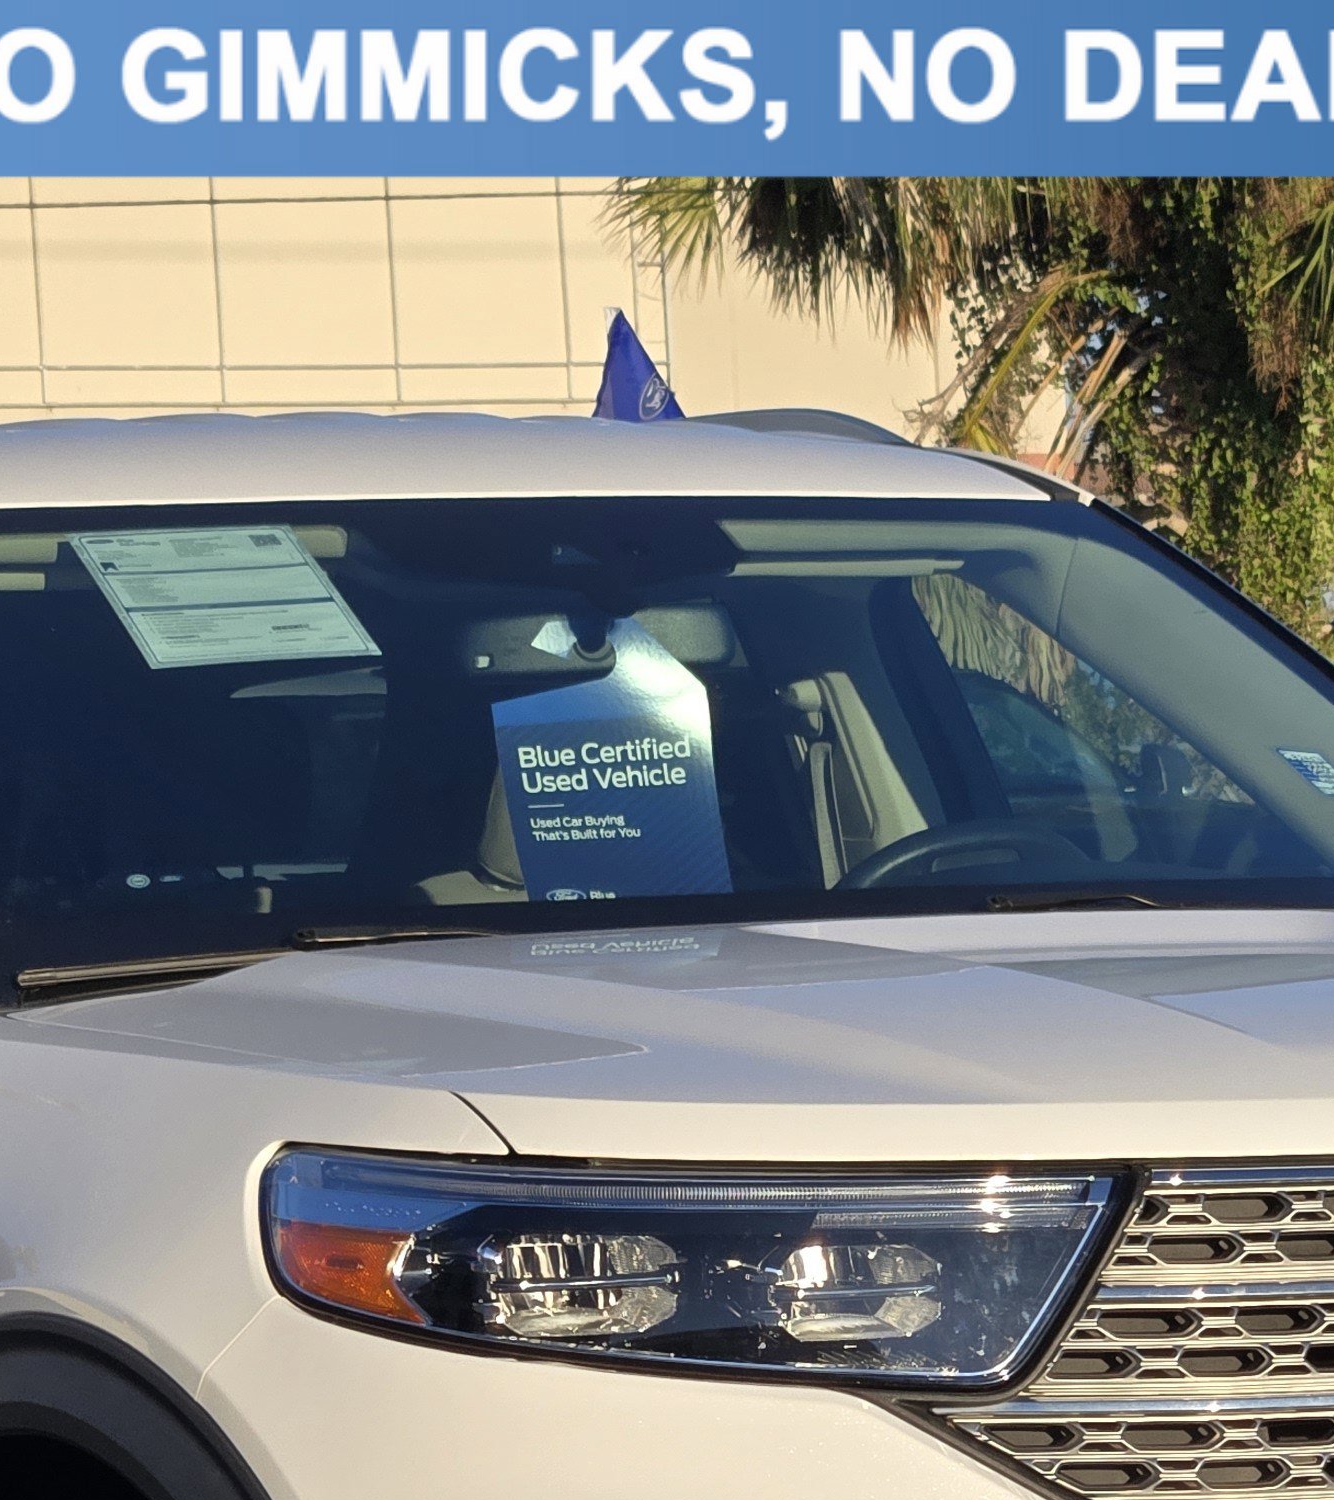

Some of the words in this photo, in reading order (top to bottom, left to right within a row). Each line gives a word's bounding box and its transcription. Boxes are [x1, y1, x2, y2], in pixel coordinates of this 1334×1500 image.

[517, 745, 576, 769] Blue
[581, 735, 691, 765] Certified
[521, 768, 589, 794] Used
[592, 763, 687, 790] Vehicle
[530, 816, 562, 829] Used
[562, 816, 583, 827] Car
[585, 815, 625, 827] Buying
[532, 830, 570, 842] That's
[571, 829, 598, 840] Built
[599, 828, 616, 839] for
[617, 827, 641, 838] You
